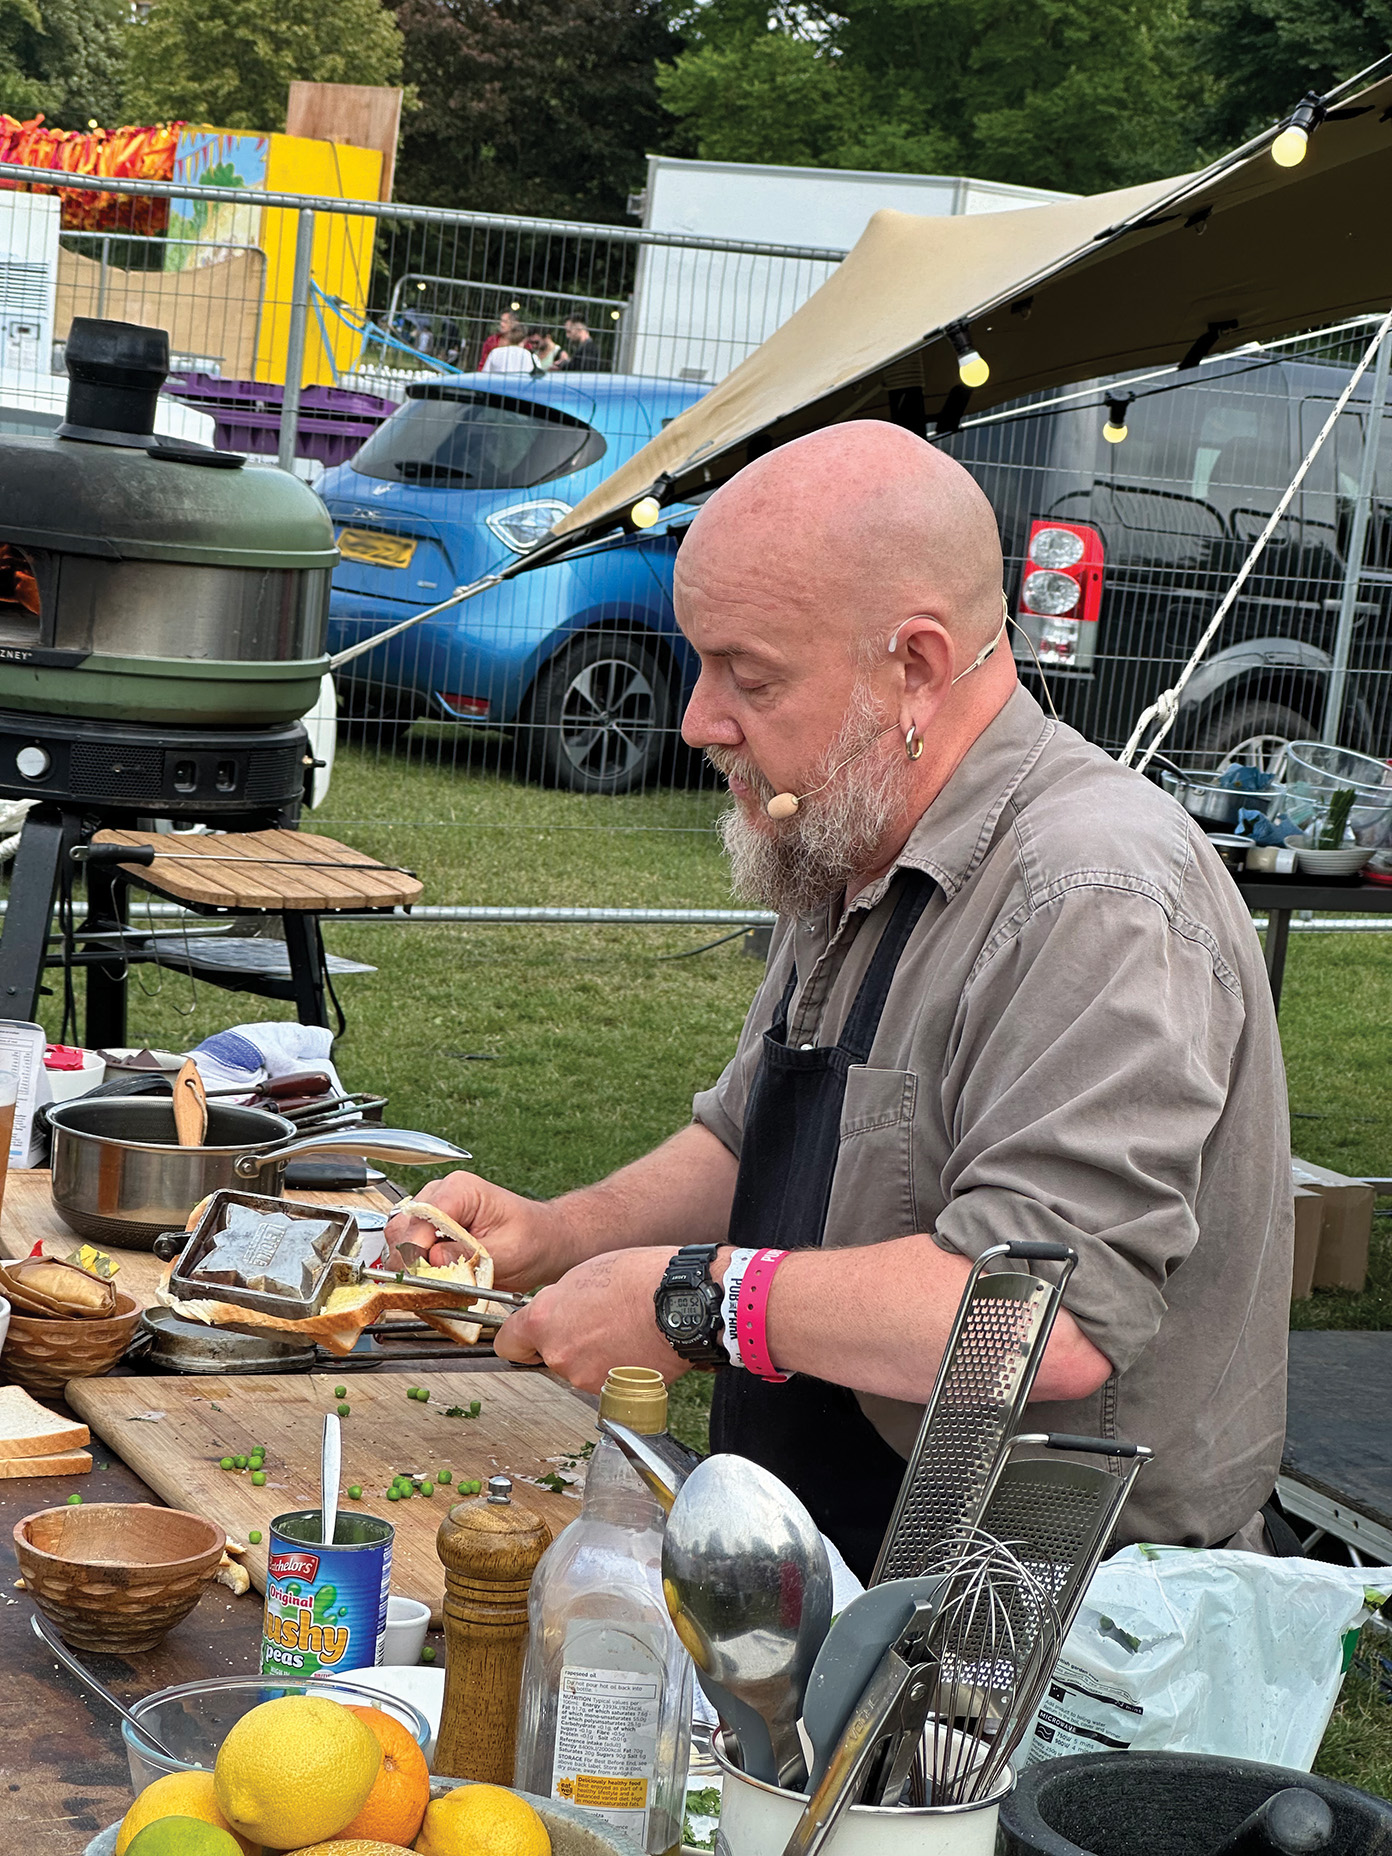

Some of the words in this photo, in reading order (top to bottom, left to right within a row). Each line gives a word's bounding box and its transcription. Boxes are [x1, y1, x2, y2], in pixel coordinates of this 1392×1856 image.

[270, 1557, 313, 1574] atchelors
[270, 1584, 313, 1608] Original
[265, 1644, 305, 1668] peas
[561, 1720, 596, 1729] Carbohydrate
[1040, 1711, 1076, 1733] MICROWAVE
[1057, 1731, 1072, 1742] 750W
[1080, 1741, 1094, 1750] mins
[559, 1747, 583, 1755] Saturates
[578, 1777, 606, 1785] Deliciously
